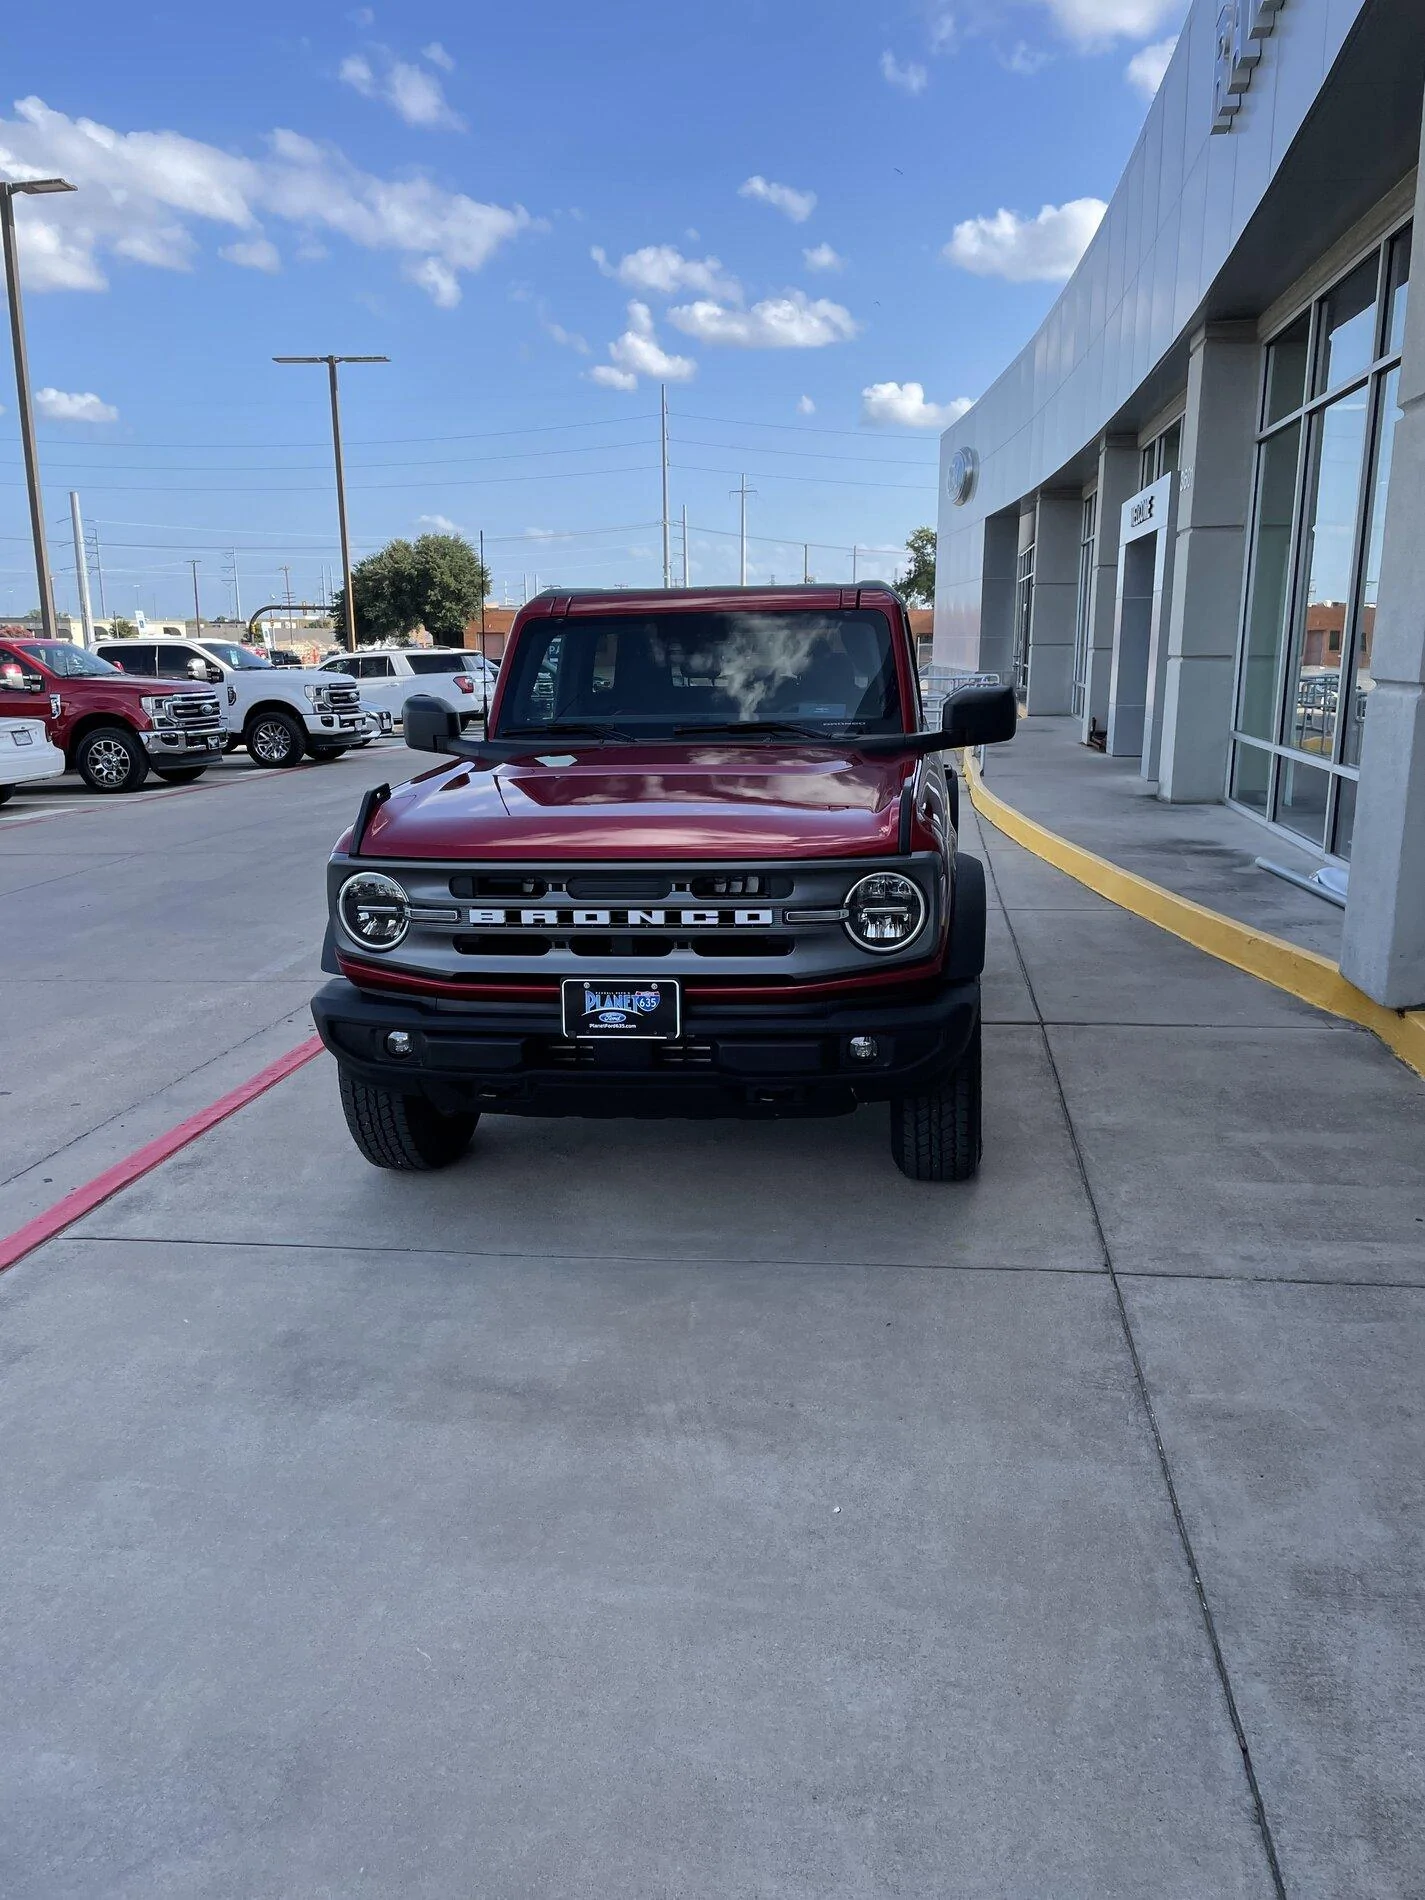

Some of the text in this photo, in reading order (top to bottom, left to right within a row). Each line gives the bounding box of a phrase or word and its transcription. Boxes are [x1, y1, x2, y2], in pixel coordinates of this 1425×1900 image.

[469, 909, 773, 925] BRONCO
[585, 990, 639, 1014] PLANET
[640, 998, 657, 1008] 635
